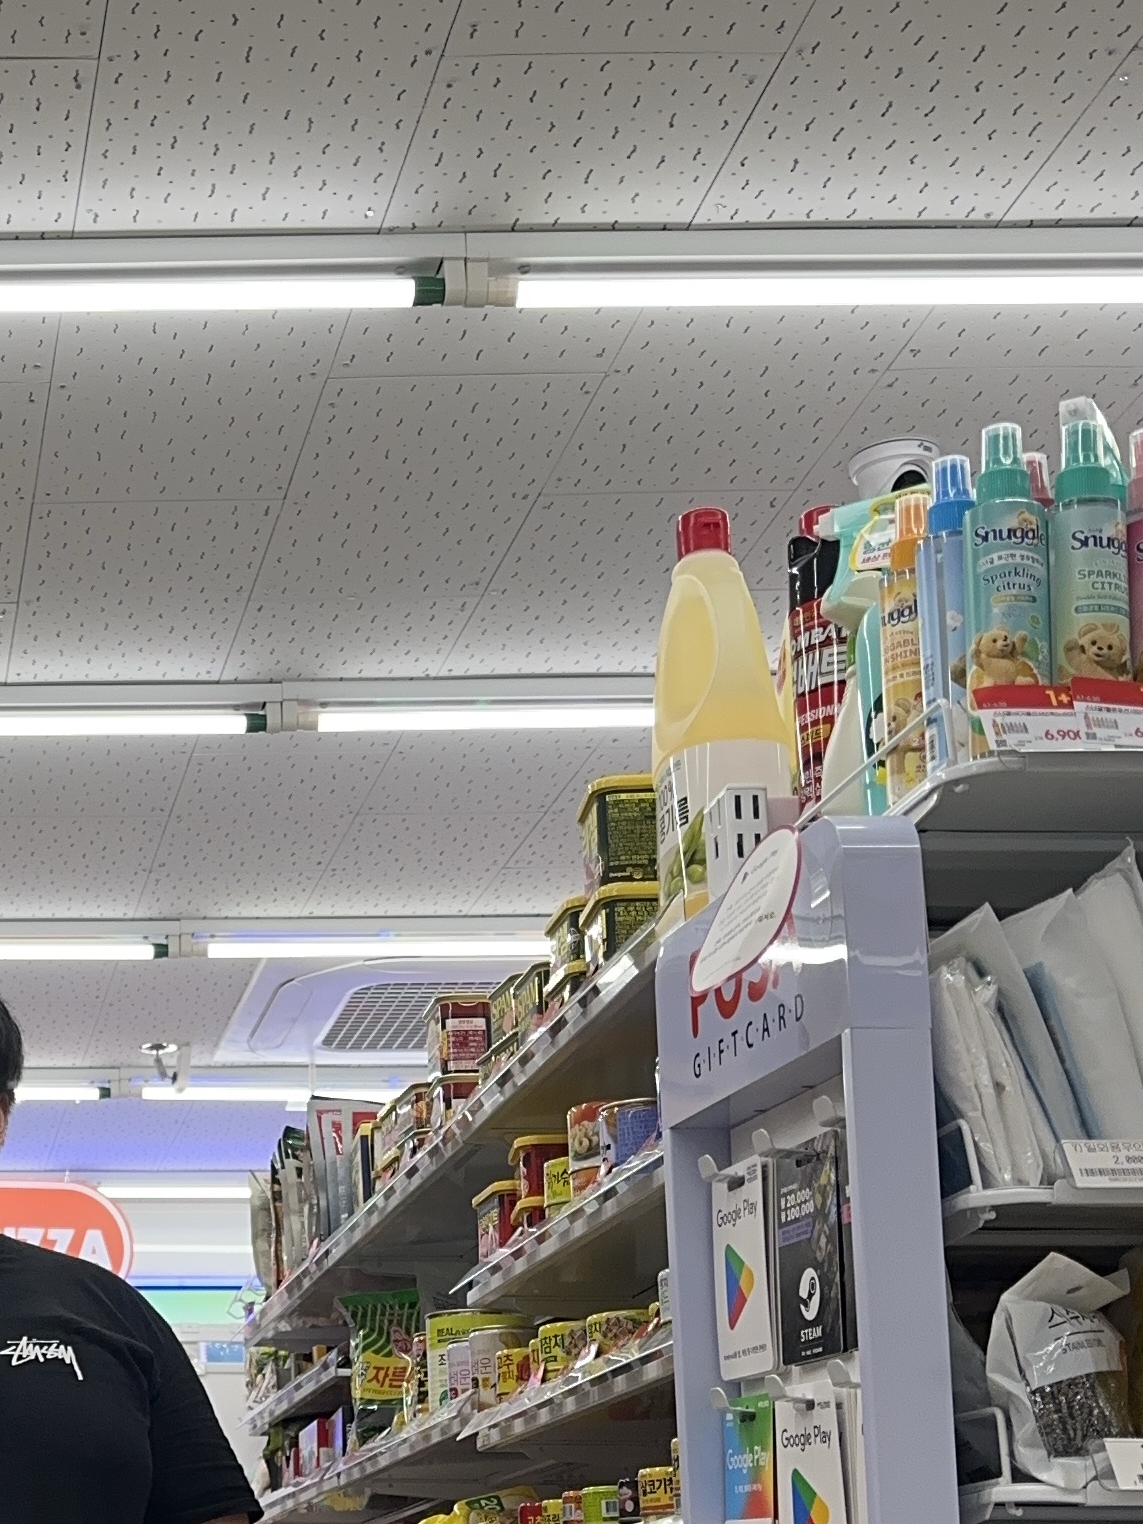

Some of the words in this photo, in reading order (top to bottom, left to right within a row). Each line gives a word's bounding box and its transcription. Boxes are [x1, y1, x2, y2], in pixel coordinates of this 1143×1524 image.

[974, 517, 1045, 548] Snuggle
[982, 566, 1042, 587] Sparkling
[995, 579, 1032, 592] citrus
[879, 598, 918, 628] uggl
[659, 796, 690, 845] 콩기름
[716, 1203, 743, 1229] Google
[742, 1199, 758, 1220] Play
[800, 1324, 823, 1342] STEAM
[781, 1427, 813, 1453] Google
[813, 1425, 832, 1449] Play
[726, 1447, 753, 1474] Google
[753, 1445, 769, 1471] Play
